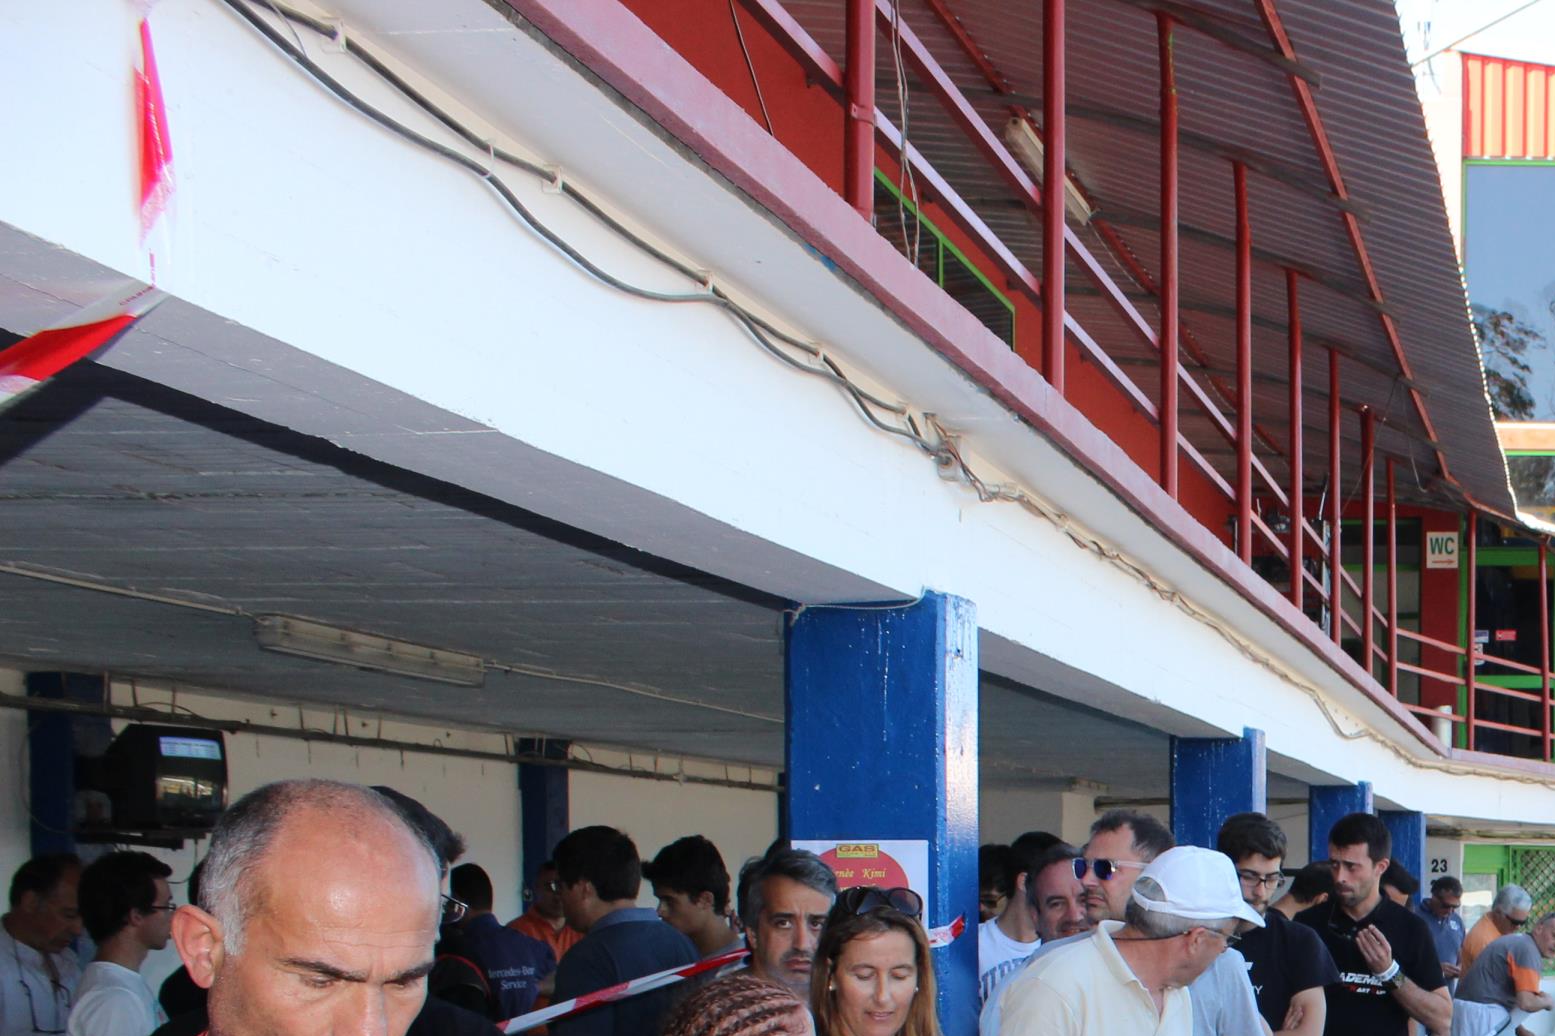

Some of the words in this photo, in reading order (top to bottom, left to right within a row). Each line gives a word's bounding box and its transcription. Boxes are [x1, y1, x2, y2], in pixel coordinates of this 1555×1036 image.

[1430, 537, 1455, 555] WC
[838, 844, 876, 853] GAS
[1431, 858, 1448, 873] 23
